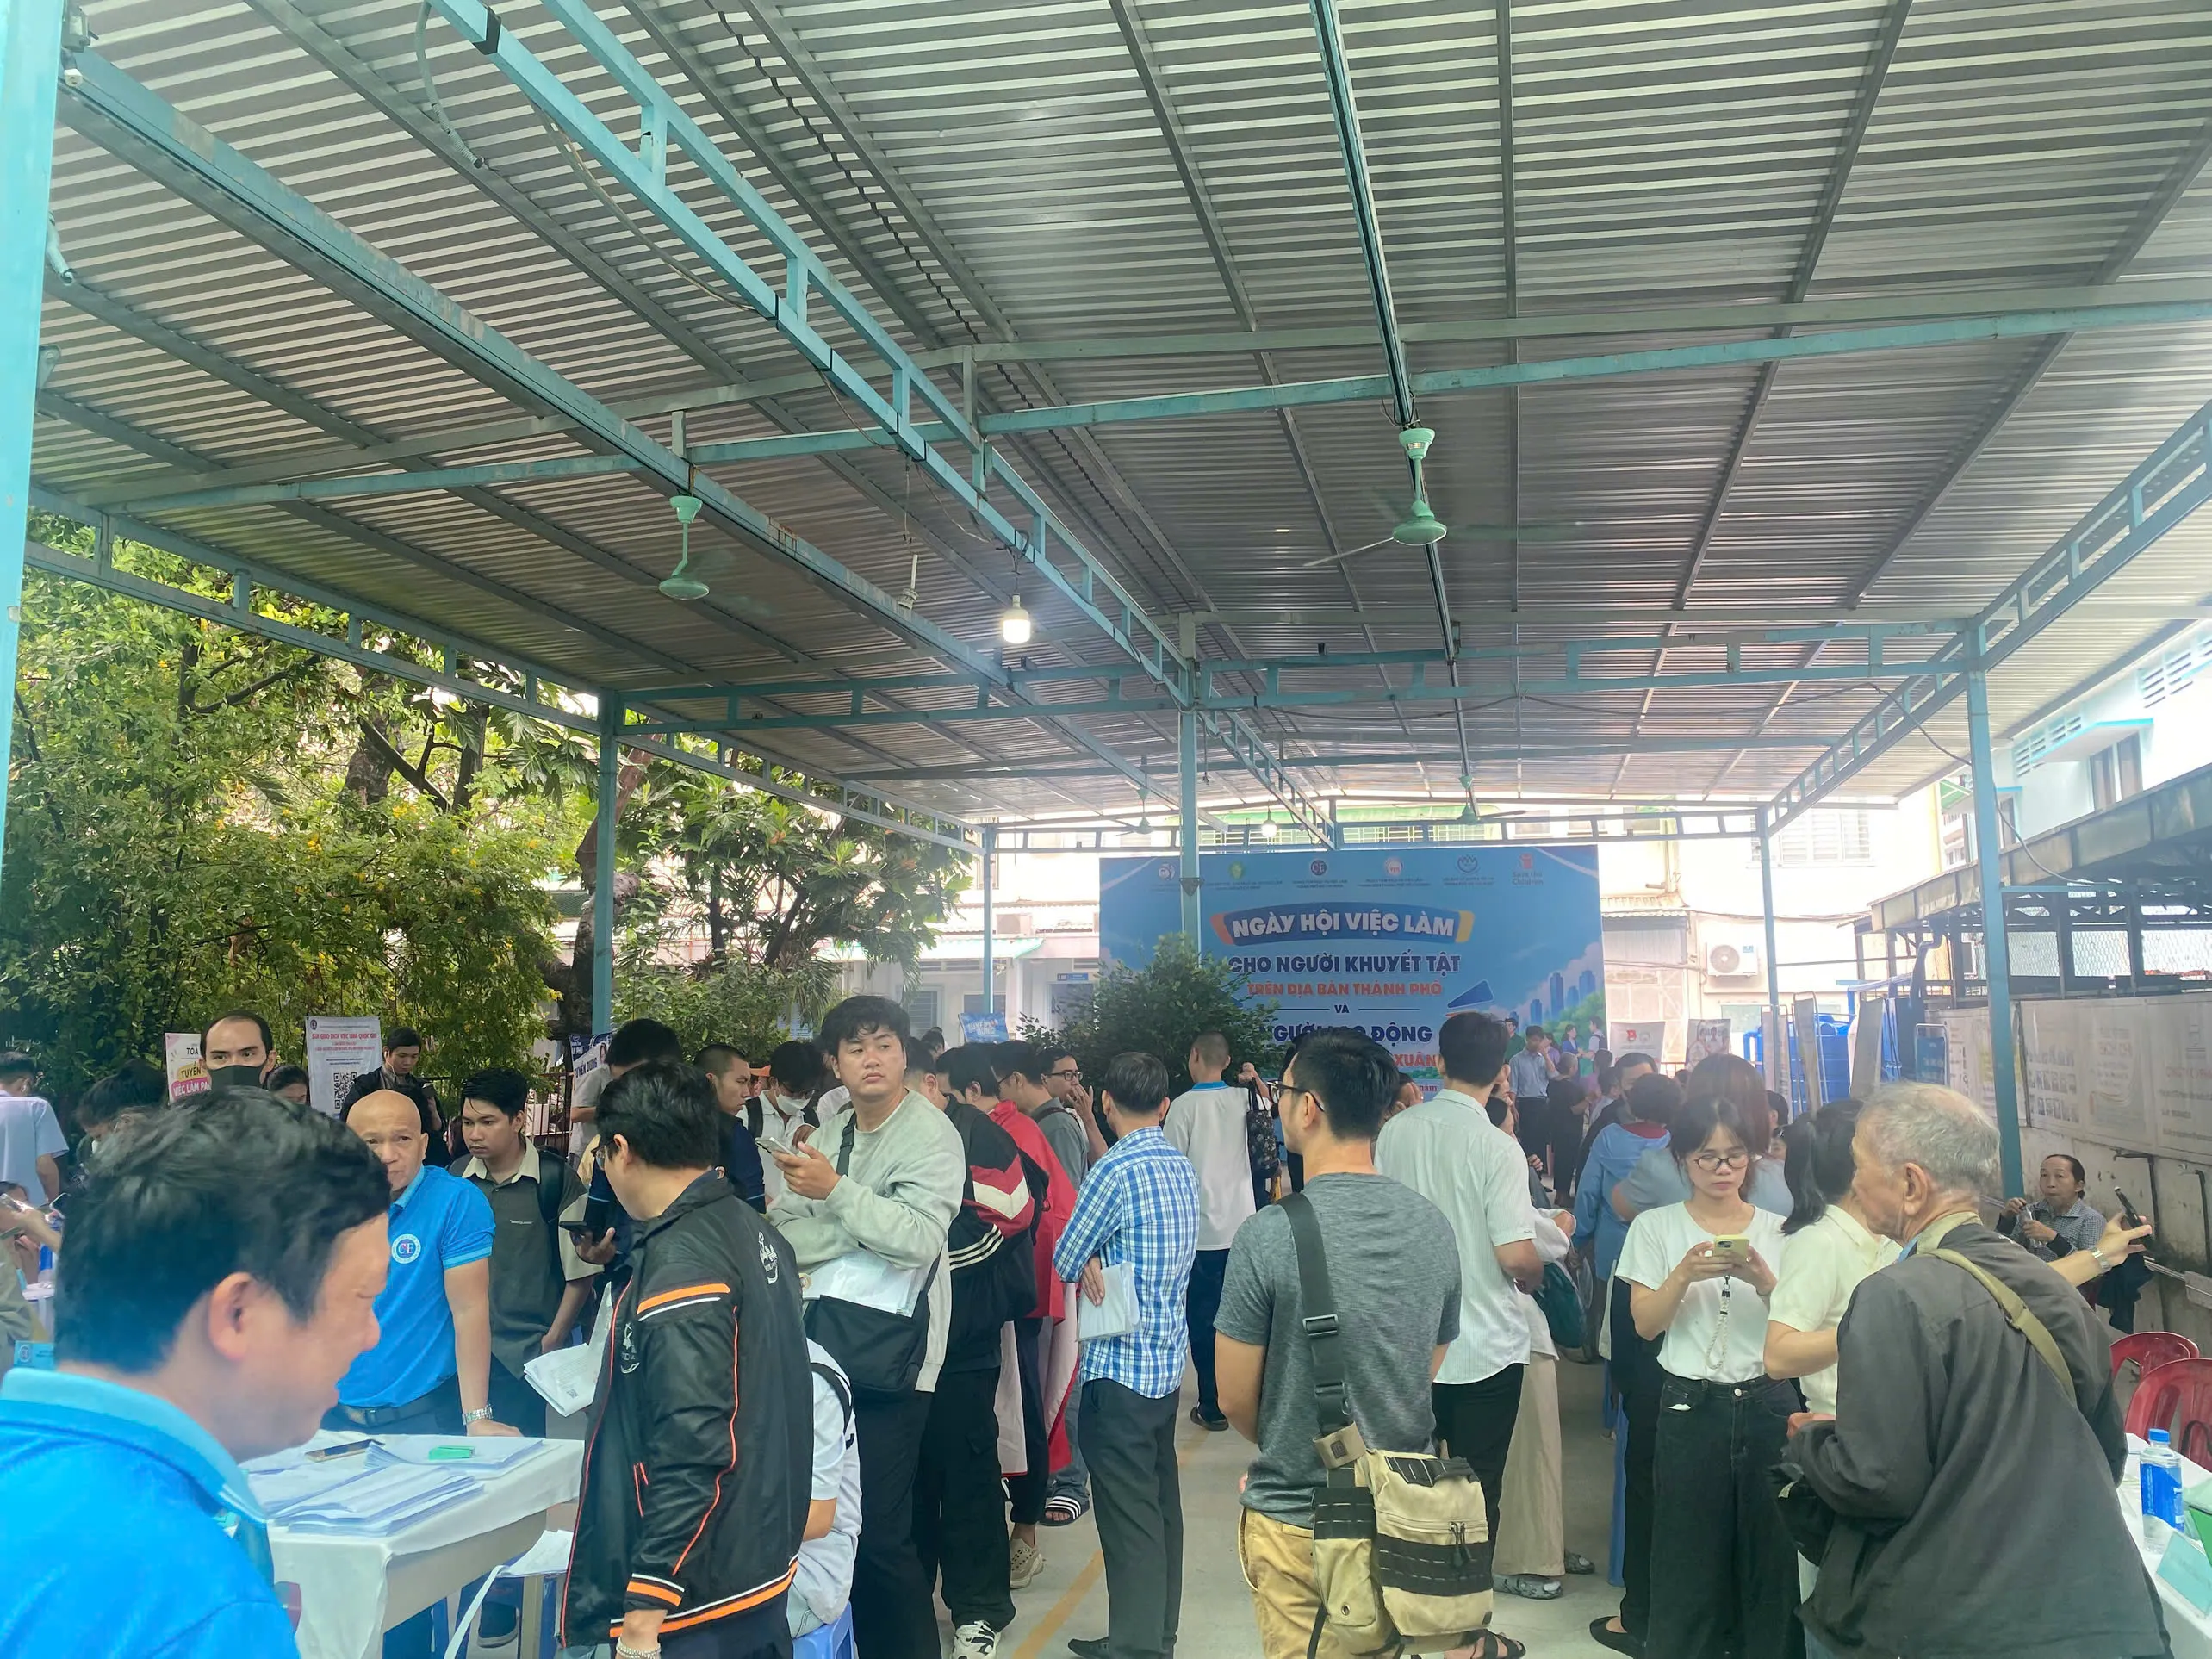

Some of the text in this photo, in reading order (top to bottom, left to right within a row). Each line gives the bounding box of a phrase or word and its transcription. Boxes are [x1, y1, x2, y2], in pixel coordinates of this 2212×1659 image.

[1512, 878, 1544, 886] Children
[1233, 909, 1454, 938] NGÀY HỘI VIỆC LÀM
[1229, 948, 1461, 977] CHO NGƯỜI KHUYẾT TẬT
[1247, 980, 1283, 996] TRÊN
[1287, 982, 1314, 999] ĐỊA
[1317, 979, 1350, 996] BÀN
[1352, 979, 1406, 996] THÀNH
[1334, 1003, 1350, 1014] VÀ
[1371, 1022, 1433, 1046] ĐỘNG
[1394, 1051, 1437, 1067] XUÂN
